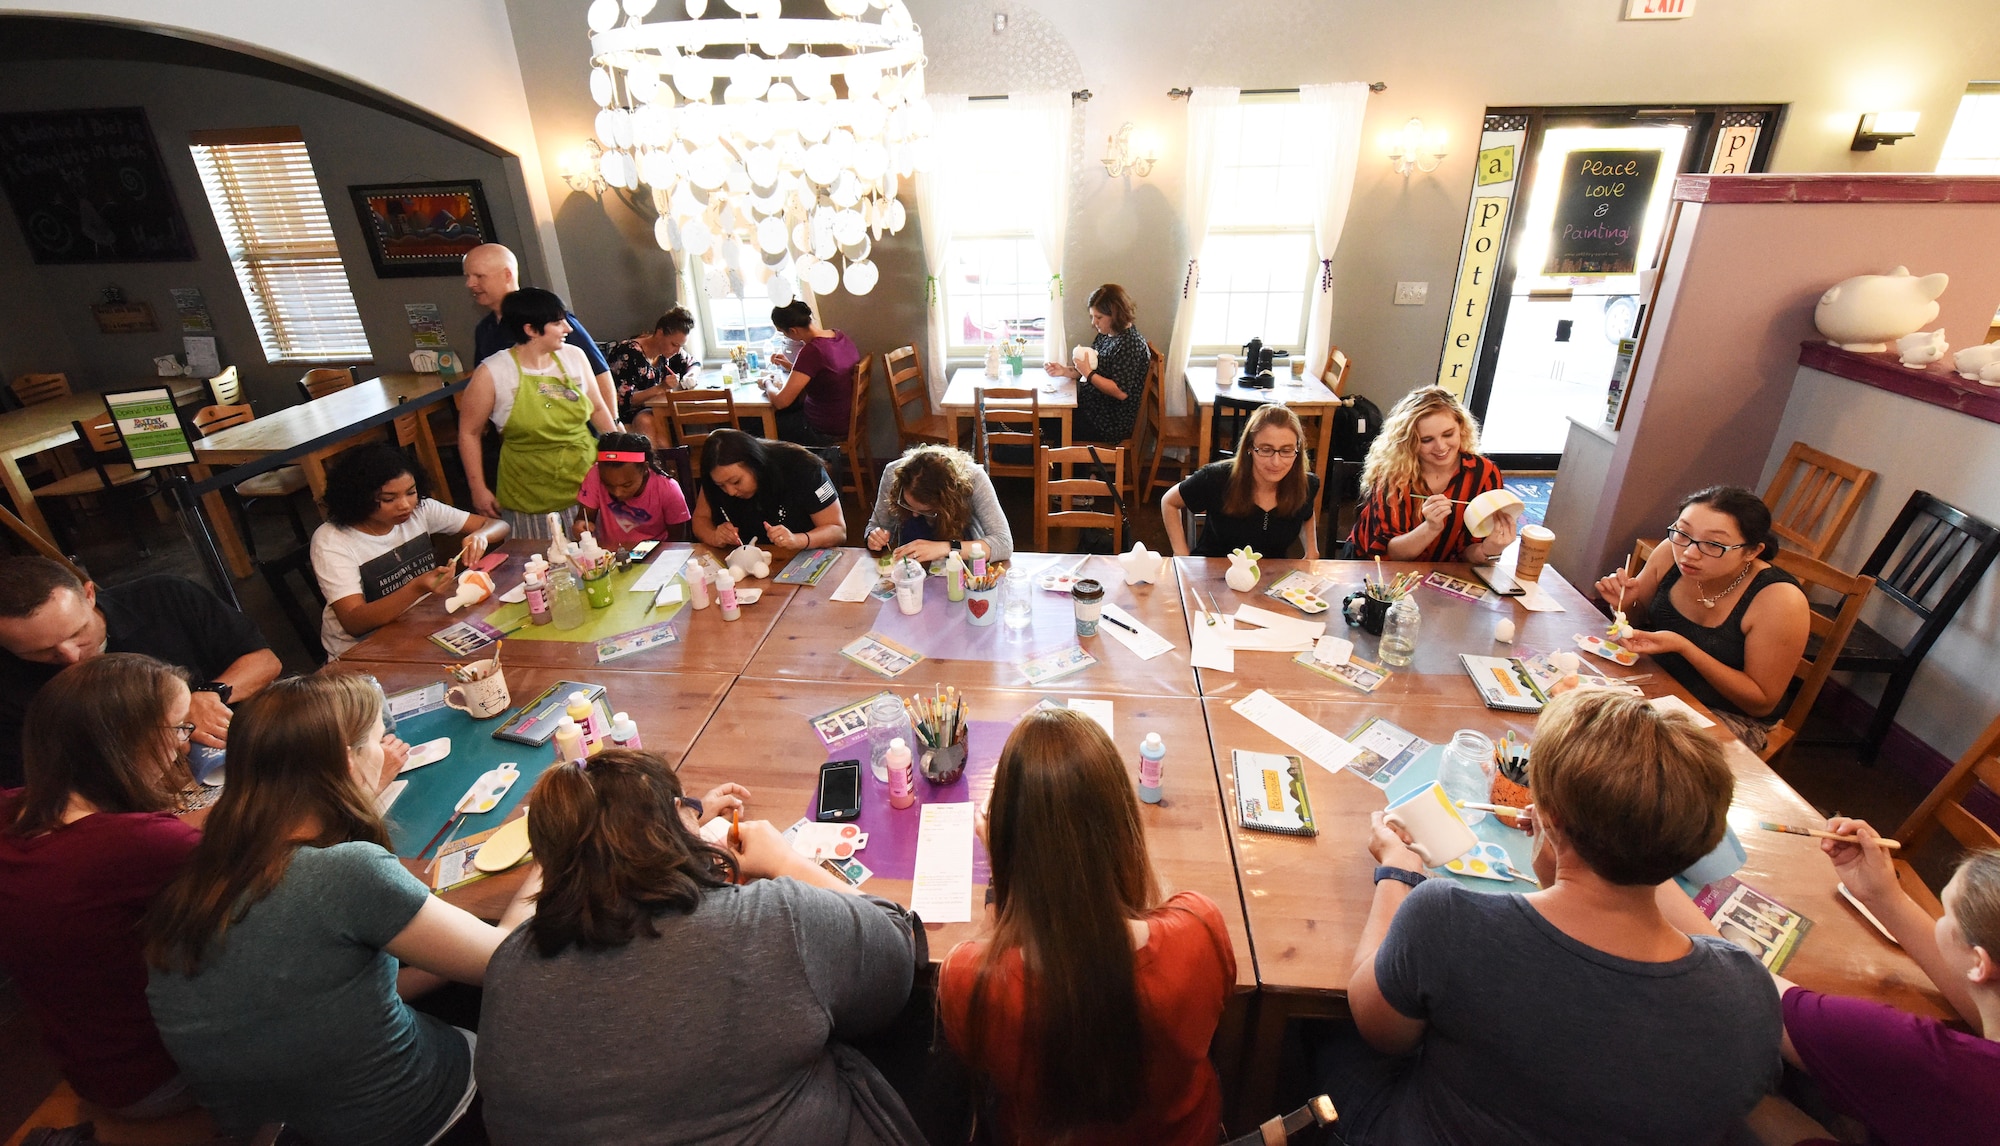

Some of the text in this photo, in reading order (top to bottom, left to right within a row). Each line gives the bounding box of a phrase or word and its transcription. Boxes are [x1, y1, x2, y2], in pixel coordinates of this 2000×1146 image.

[1489, 156, 1502, 174] a
[1581, 159, 1640, 177] Peace,
[1594, 203, 1610, 217] &
[1562, 222, 1632, 246] Painting!
[1450, 200, 1499, 398] potter
[116, 409, 141, 417] Opens
[414, 565, 430, 577] 1892
